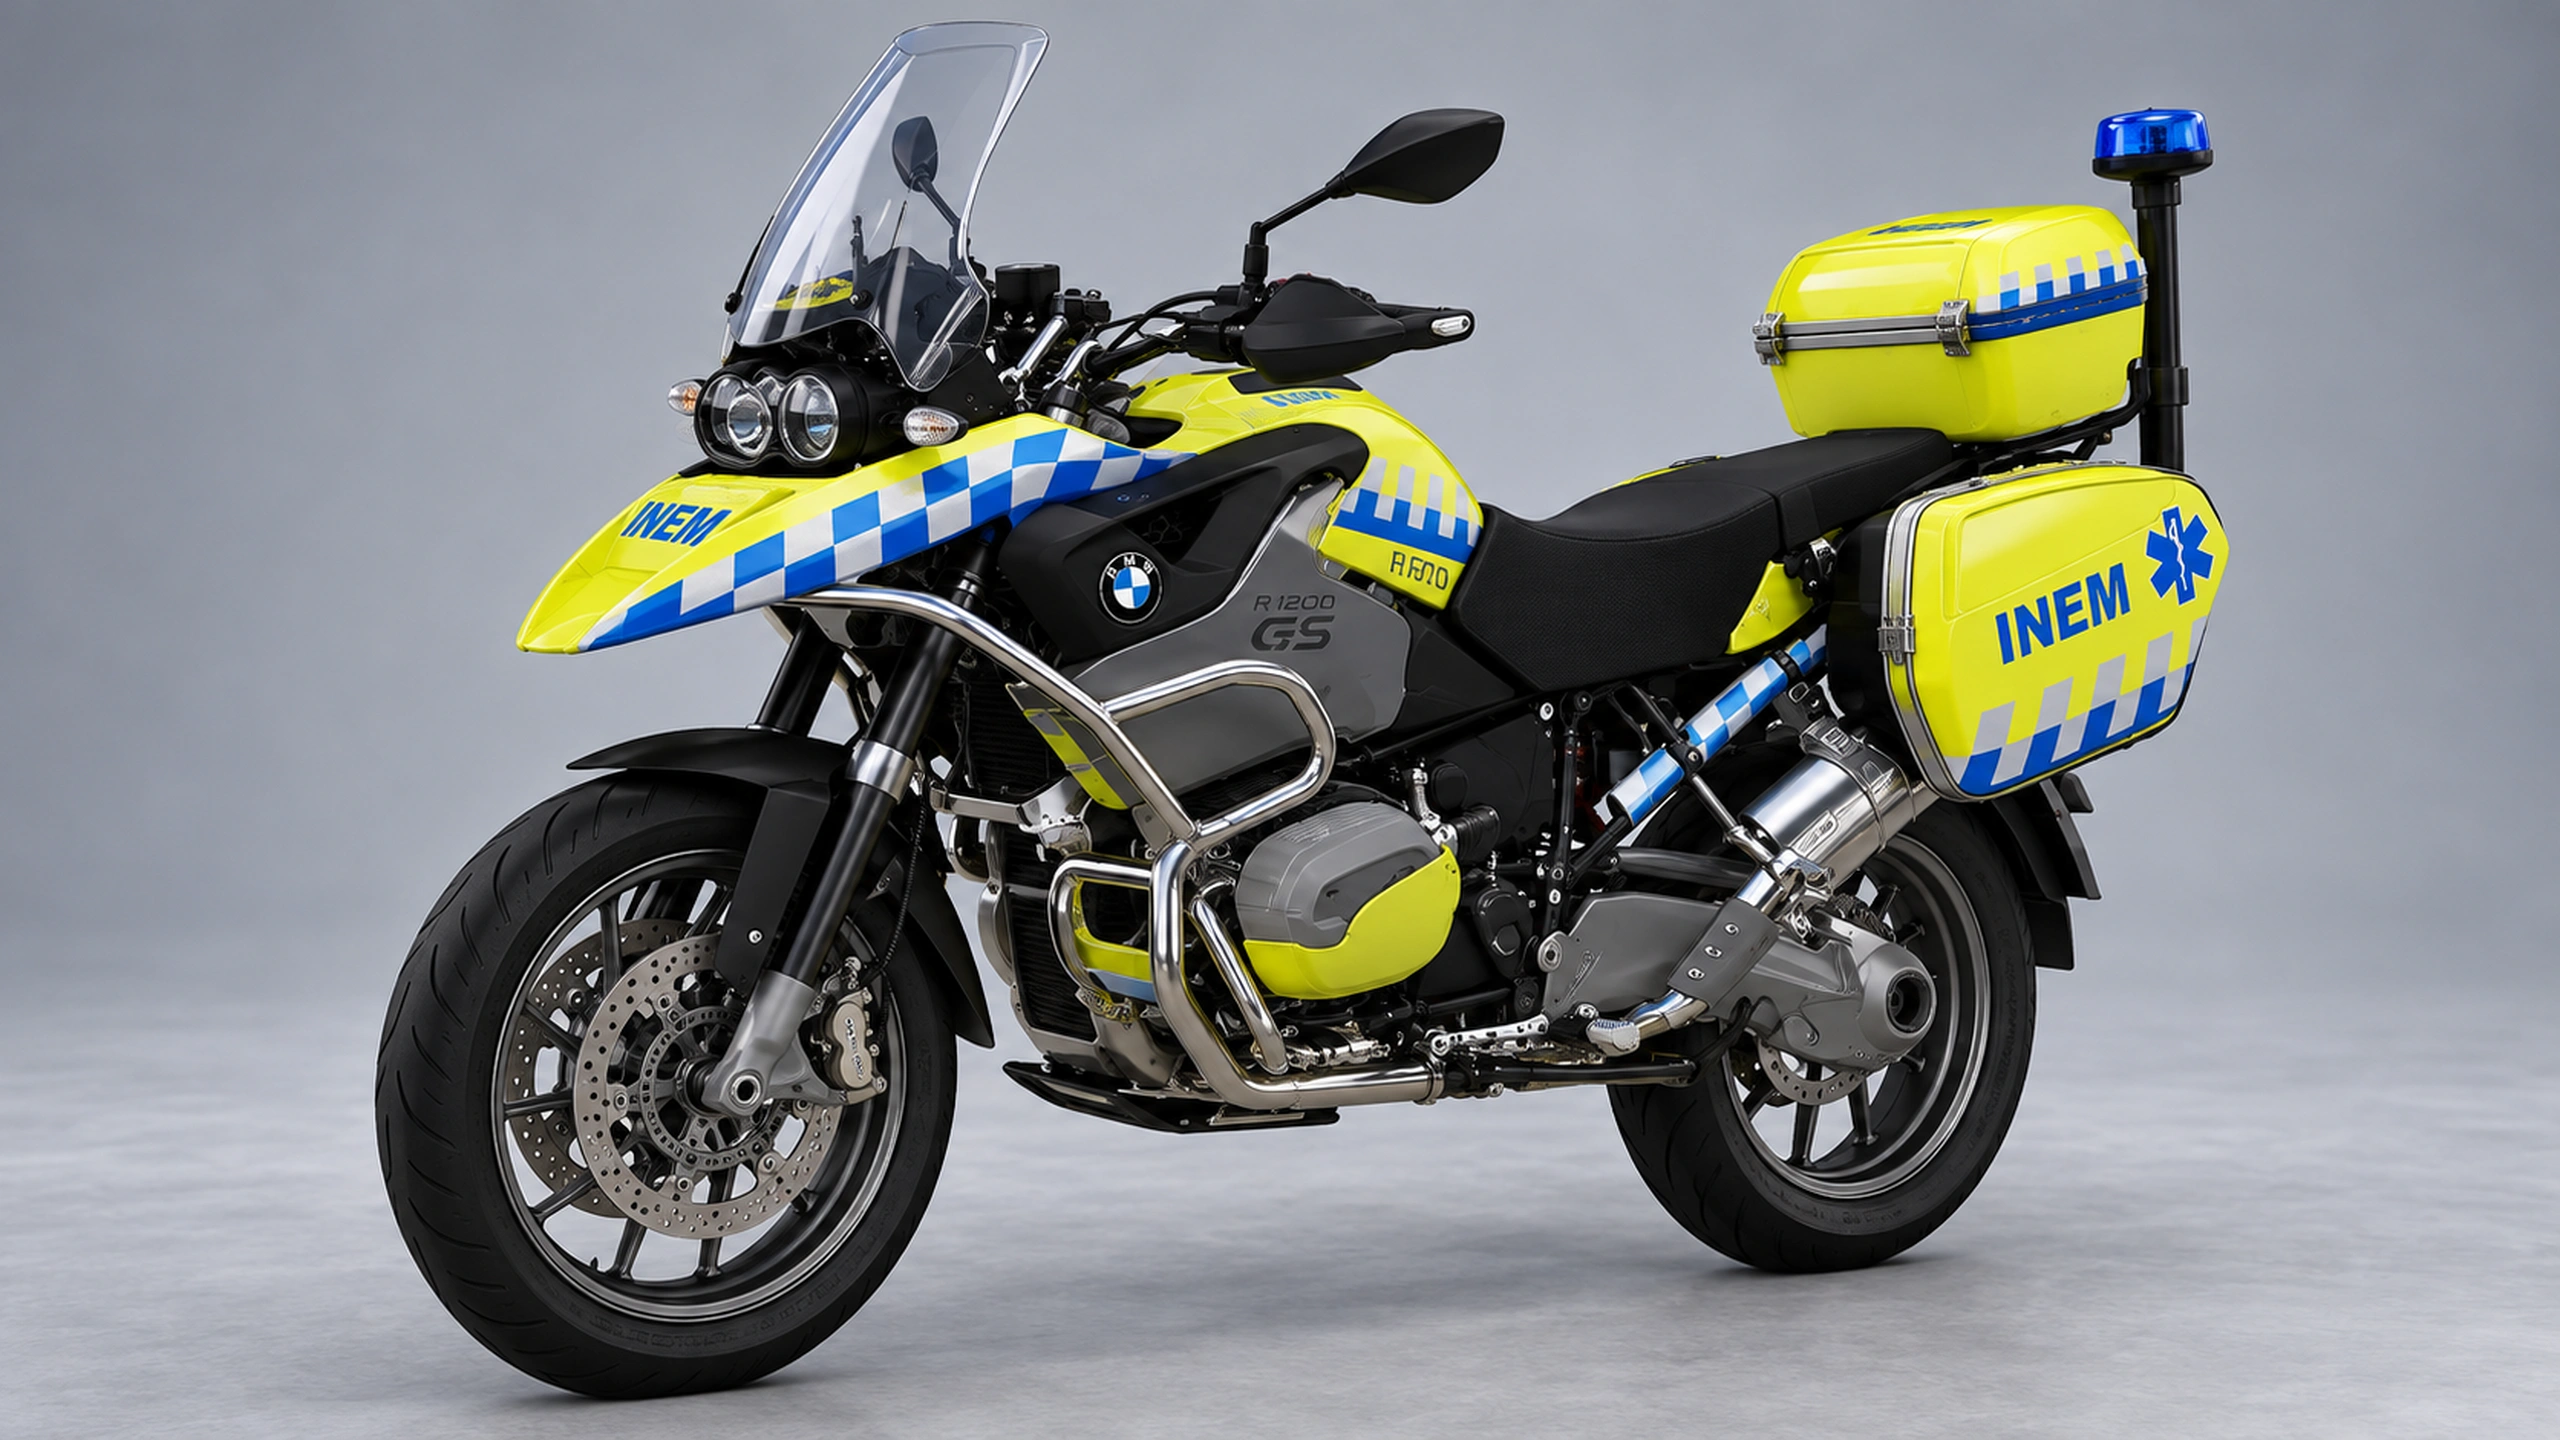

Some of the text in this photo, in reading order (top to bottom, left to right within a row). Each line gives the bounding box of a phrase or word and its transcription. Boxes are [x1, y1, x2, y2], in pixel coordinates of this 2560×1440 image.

[620, 500, 733, 547] INEM
[1253, 595, 1336, 611] R 1200
[1995, 562, 2131, 665] INEM
[1251, 615, 1336, 651] GS
